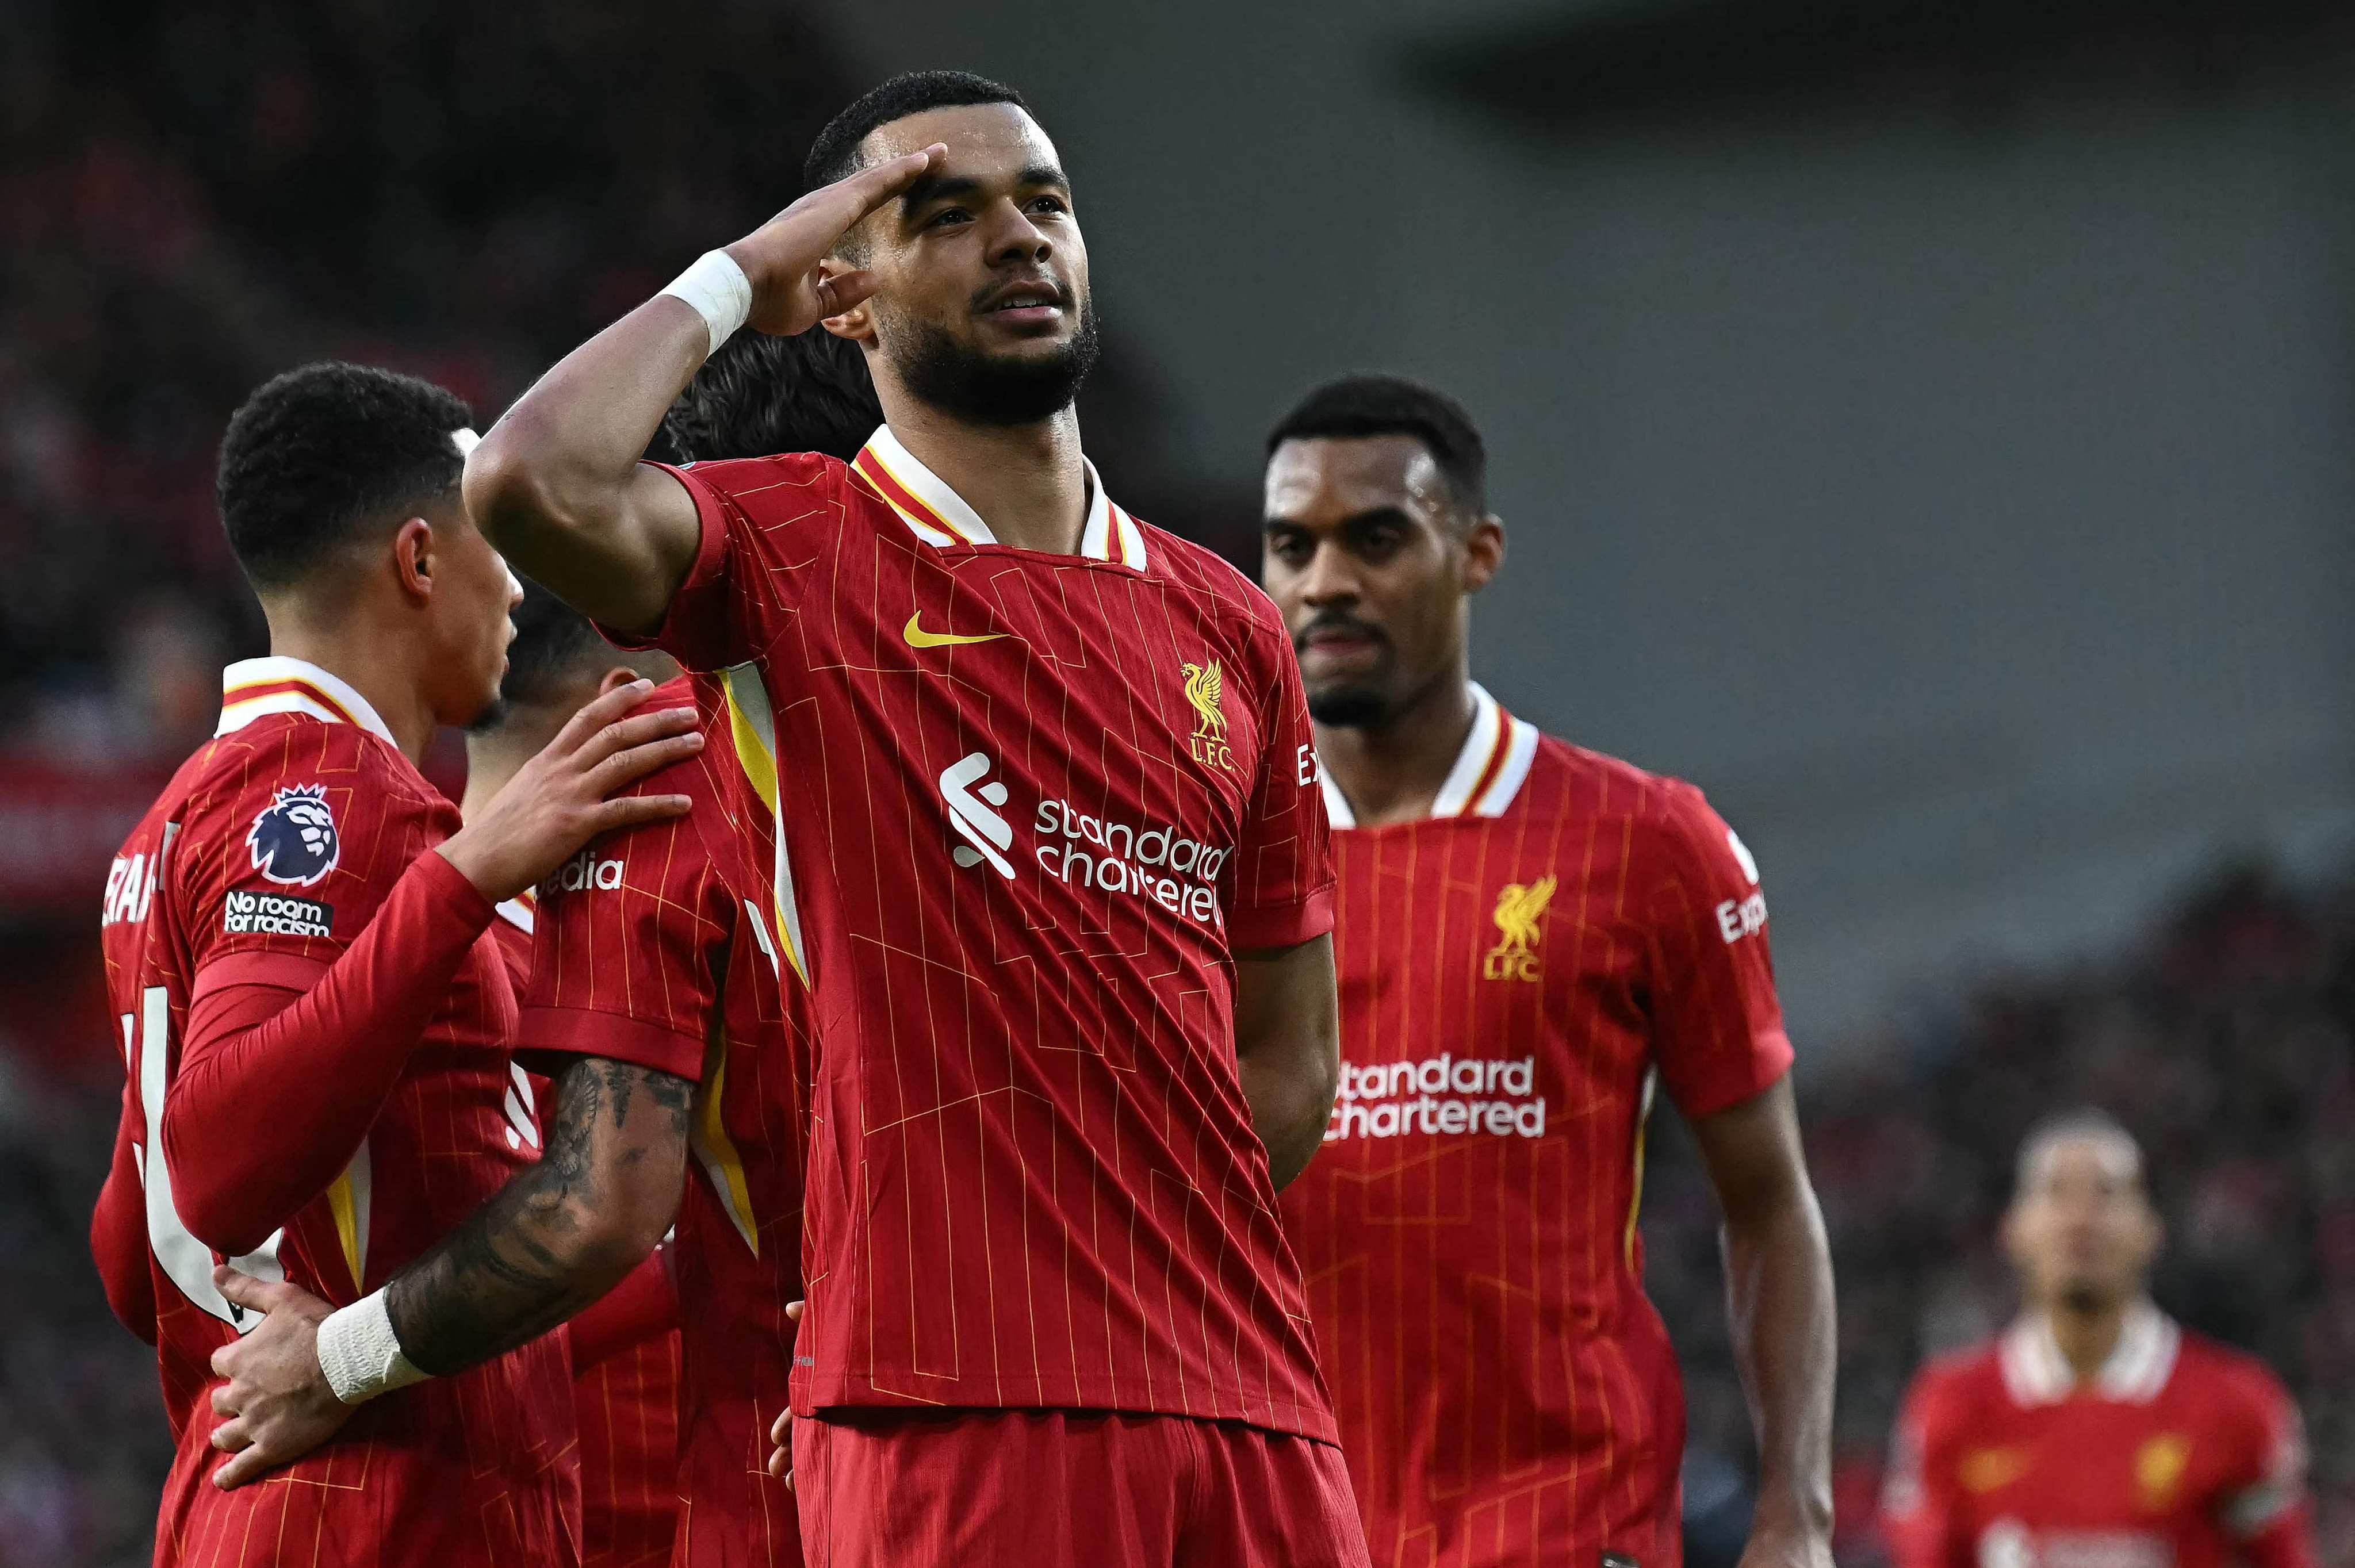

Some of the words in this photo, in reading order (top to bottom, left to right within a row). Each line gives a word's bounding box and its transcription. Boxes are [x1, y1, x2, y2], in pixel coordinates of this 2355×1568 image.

[1035, 799, 1235, 881] standard
[224, 910, 253, 932] for
[253, 914, 330, 938] racism
[225, 891, 256, 913] No
[258, 896, 322, 923] room
[1334, 1052, 1535, 1101] tandard
